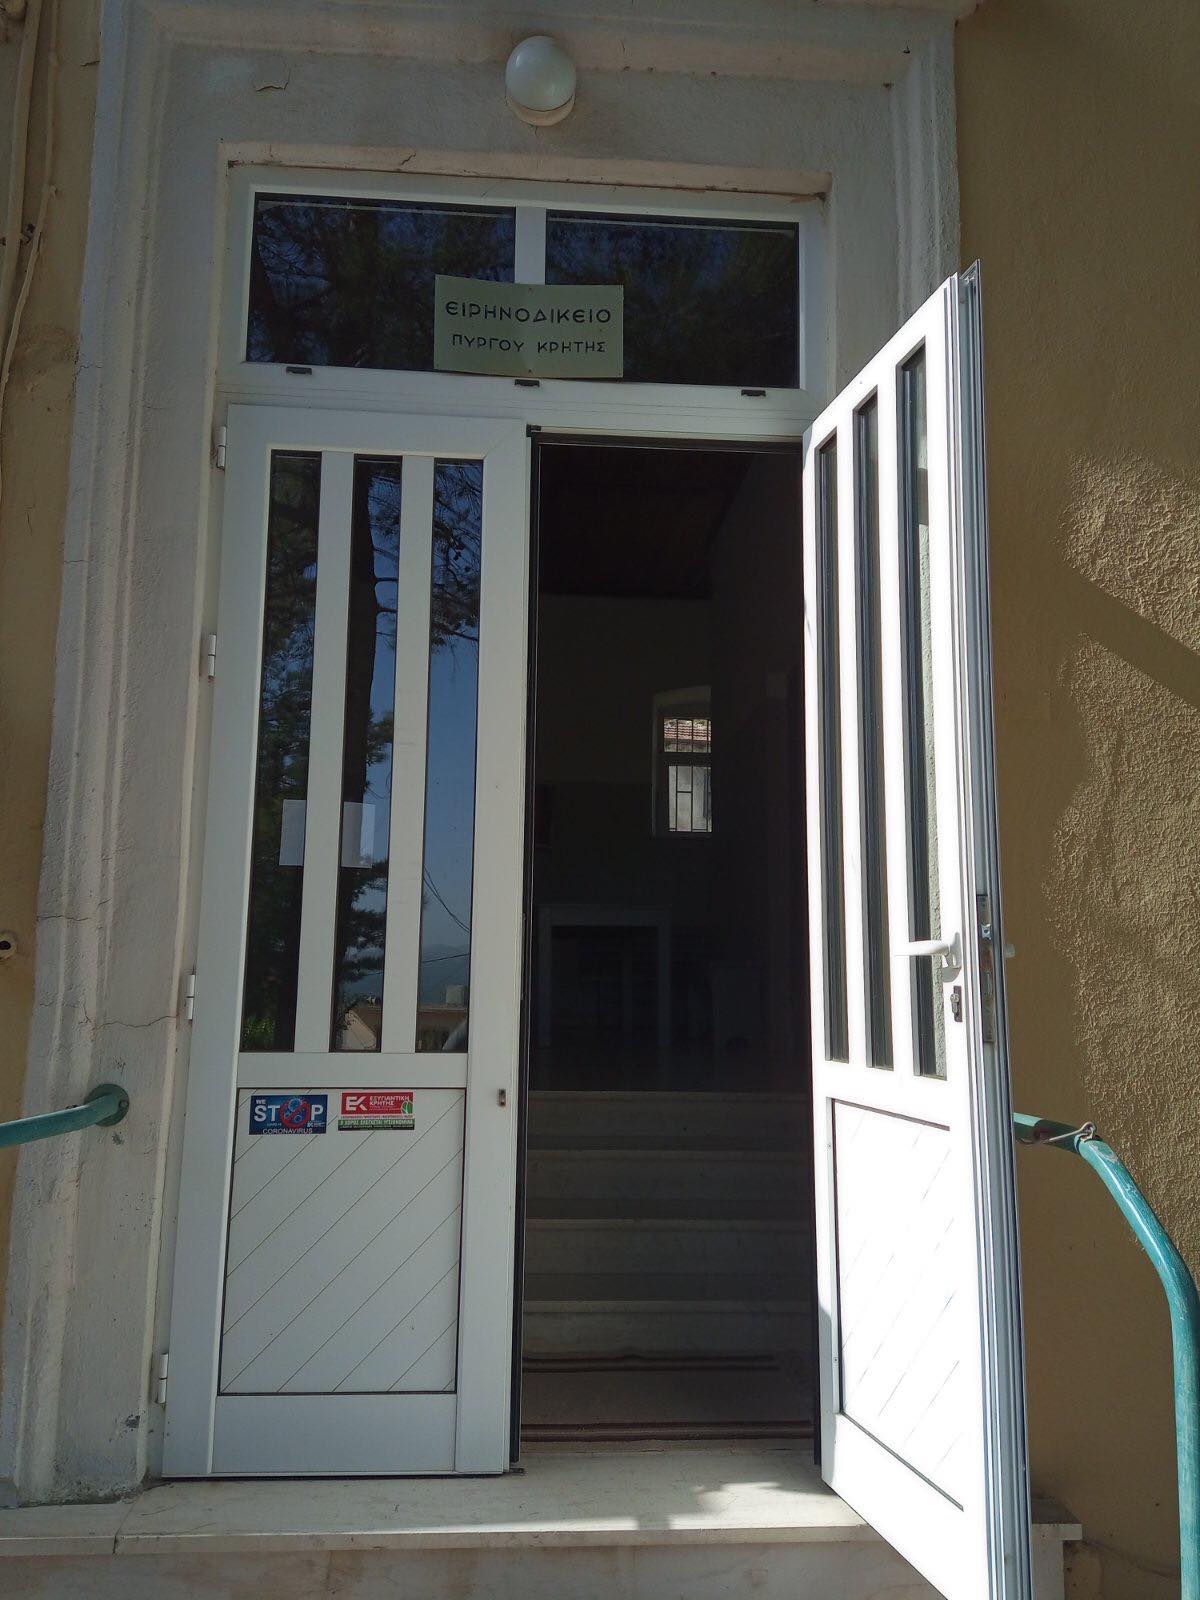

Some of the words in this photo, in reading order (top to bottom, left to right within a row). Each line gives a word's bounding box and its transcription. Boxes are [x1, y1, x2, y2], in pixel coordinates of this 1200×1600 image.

[445, 300, 612, 324] ΕΙΡΗΝΟΔΙΚΕΙΟ
[452, 333, 525, 352] ΠΥΡΓΟΥ
[537, 340, 608, 354] ΚΡΗΤΗΣ
